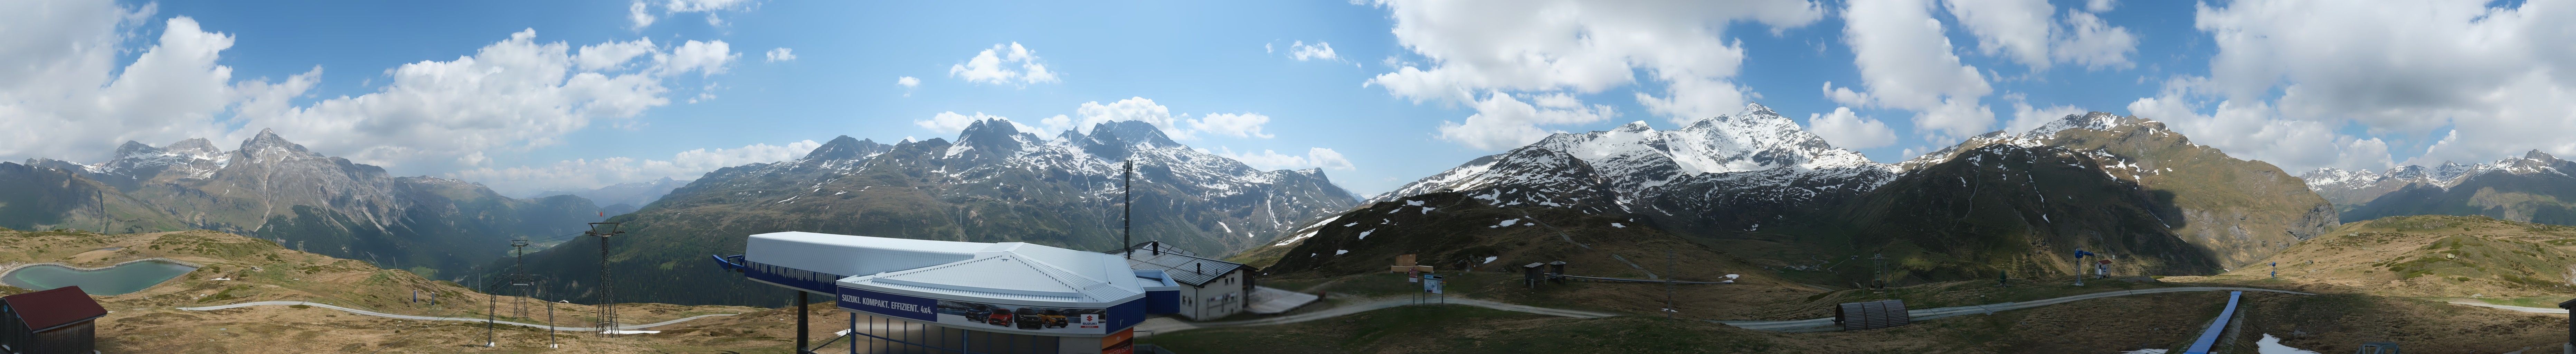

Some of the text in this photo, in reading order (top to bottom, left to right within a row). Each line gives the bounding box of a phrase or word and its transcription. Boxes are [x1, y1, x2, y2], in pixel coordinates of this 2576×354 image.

[842, 294, 933, 314] SUZUKI. KOMPAKT. EFFIZIENT. 4x4.
